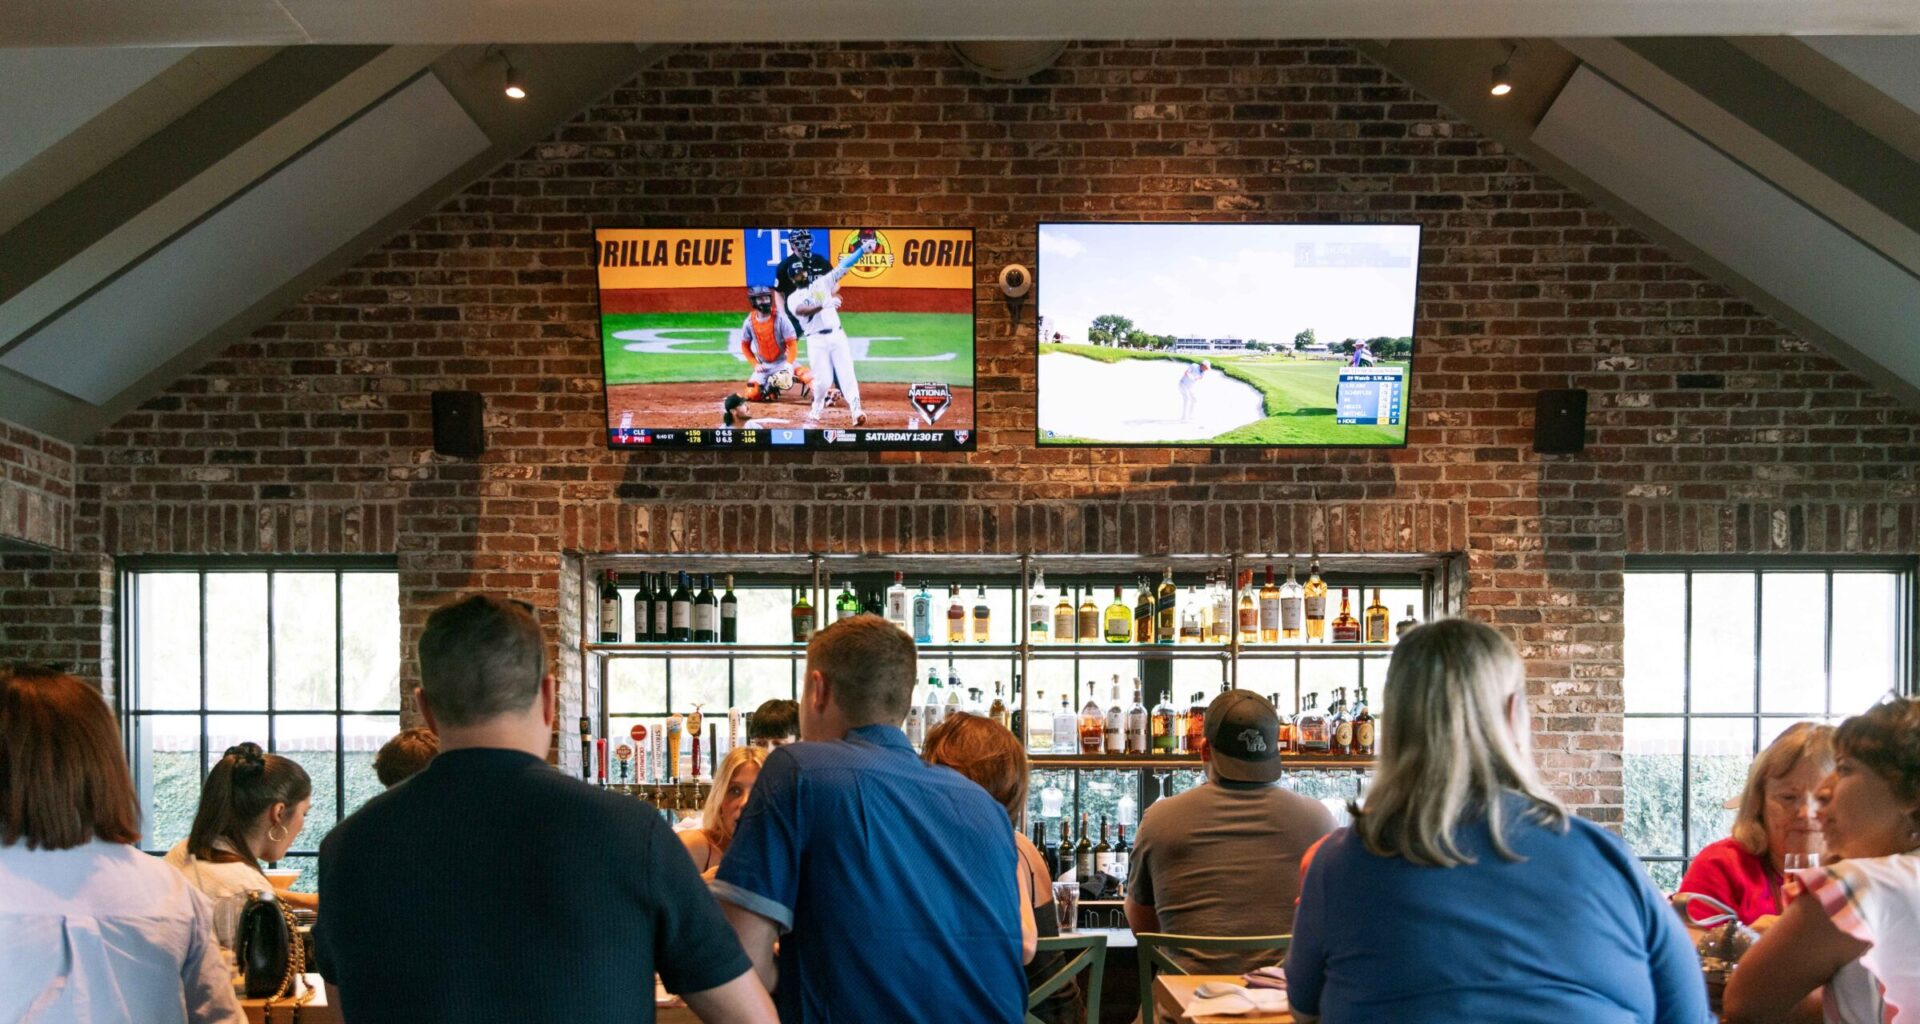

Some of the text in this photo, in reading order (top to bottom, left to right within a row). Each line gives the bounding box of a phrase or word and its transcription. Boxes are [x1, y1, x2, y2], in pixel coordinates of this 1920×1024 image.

[674, 238, 734, 266] GLUE
[860, 255, 887, 265] RILLA
[902, 239, 973, 267] GORIL
[865, 433, 912, 442] SATURDAY
[912, 433, 931, 442] 1:30
[932, 433, 944, 442] ET
